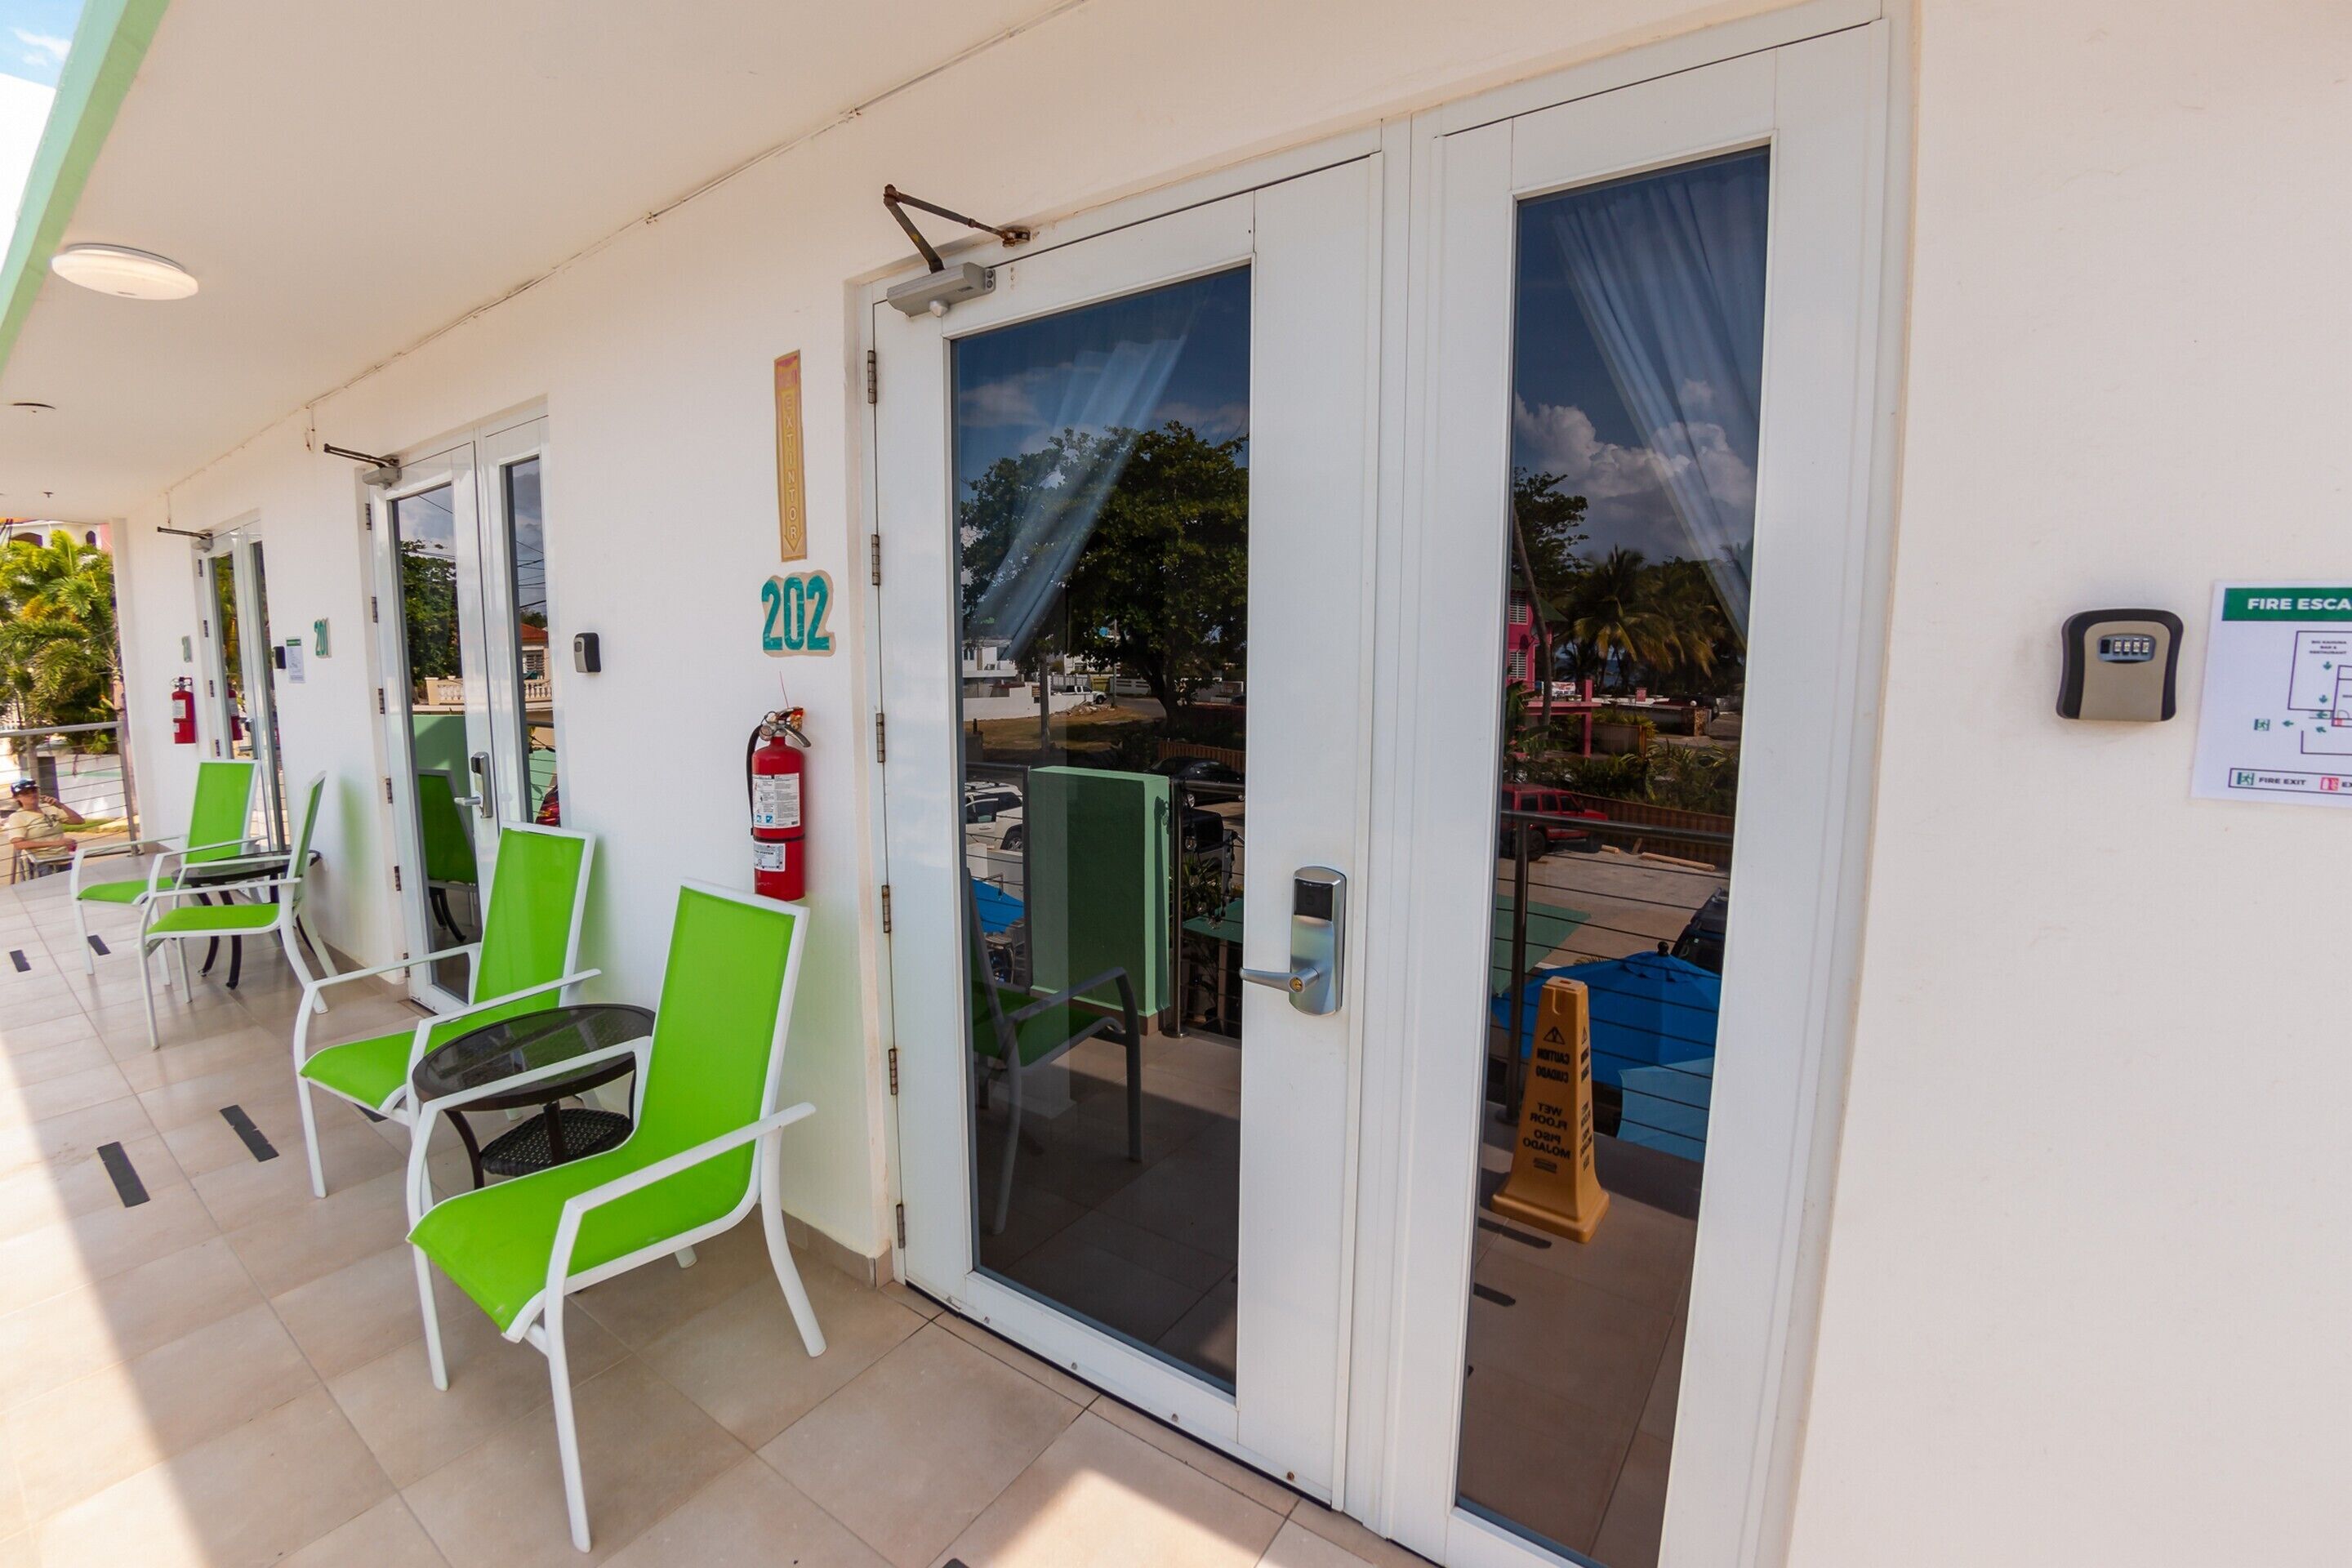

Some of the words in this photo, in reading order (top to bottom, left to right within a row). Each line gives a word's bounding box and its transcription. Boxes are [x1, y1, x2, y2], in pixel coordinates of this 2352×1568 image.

[785, 397, 798, 540] EXTINTOR
[761, 574, 831, 651] 202
[2247, 598, 2292, 610] FIRE
